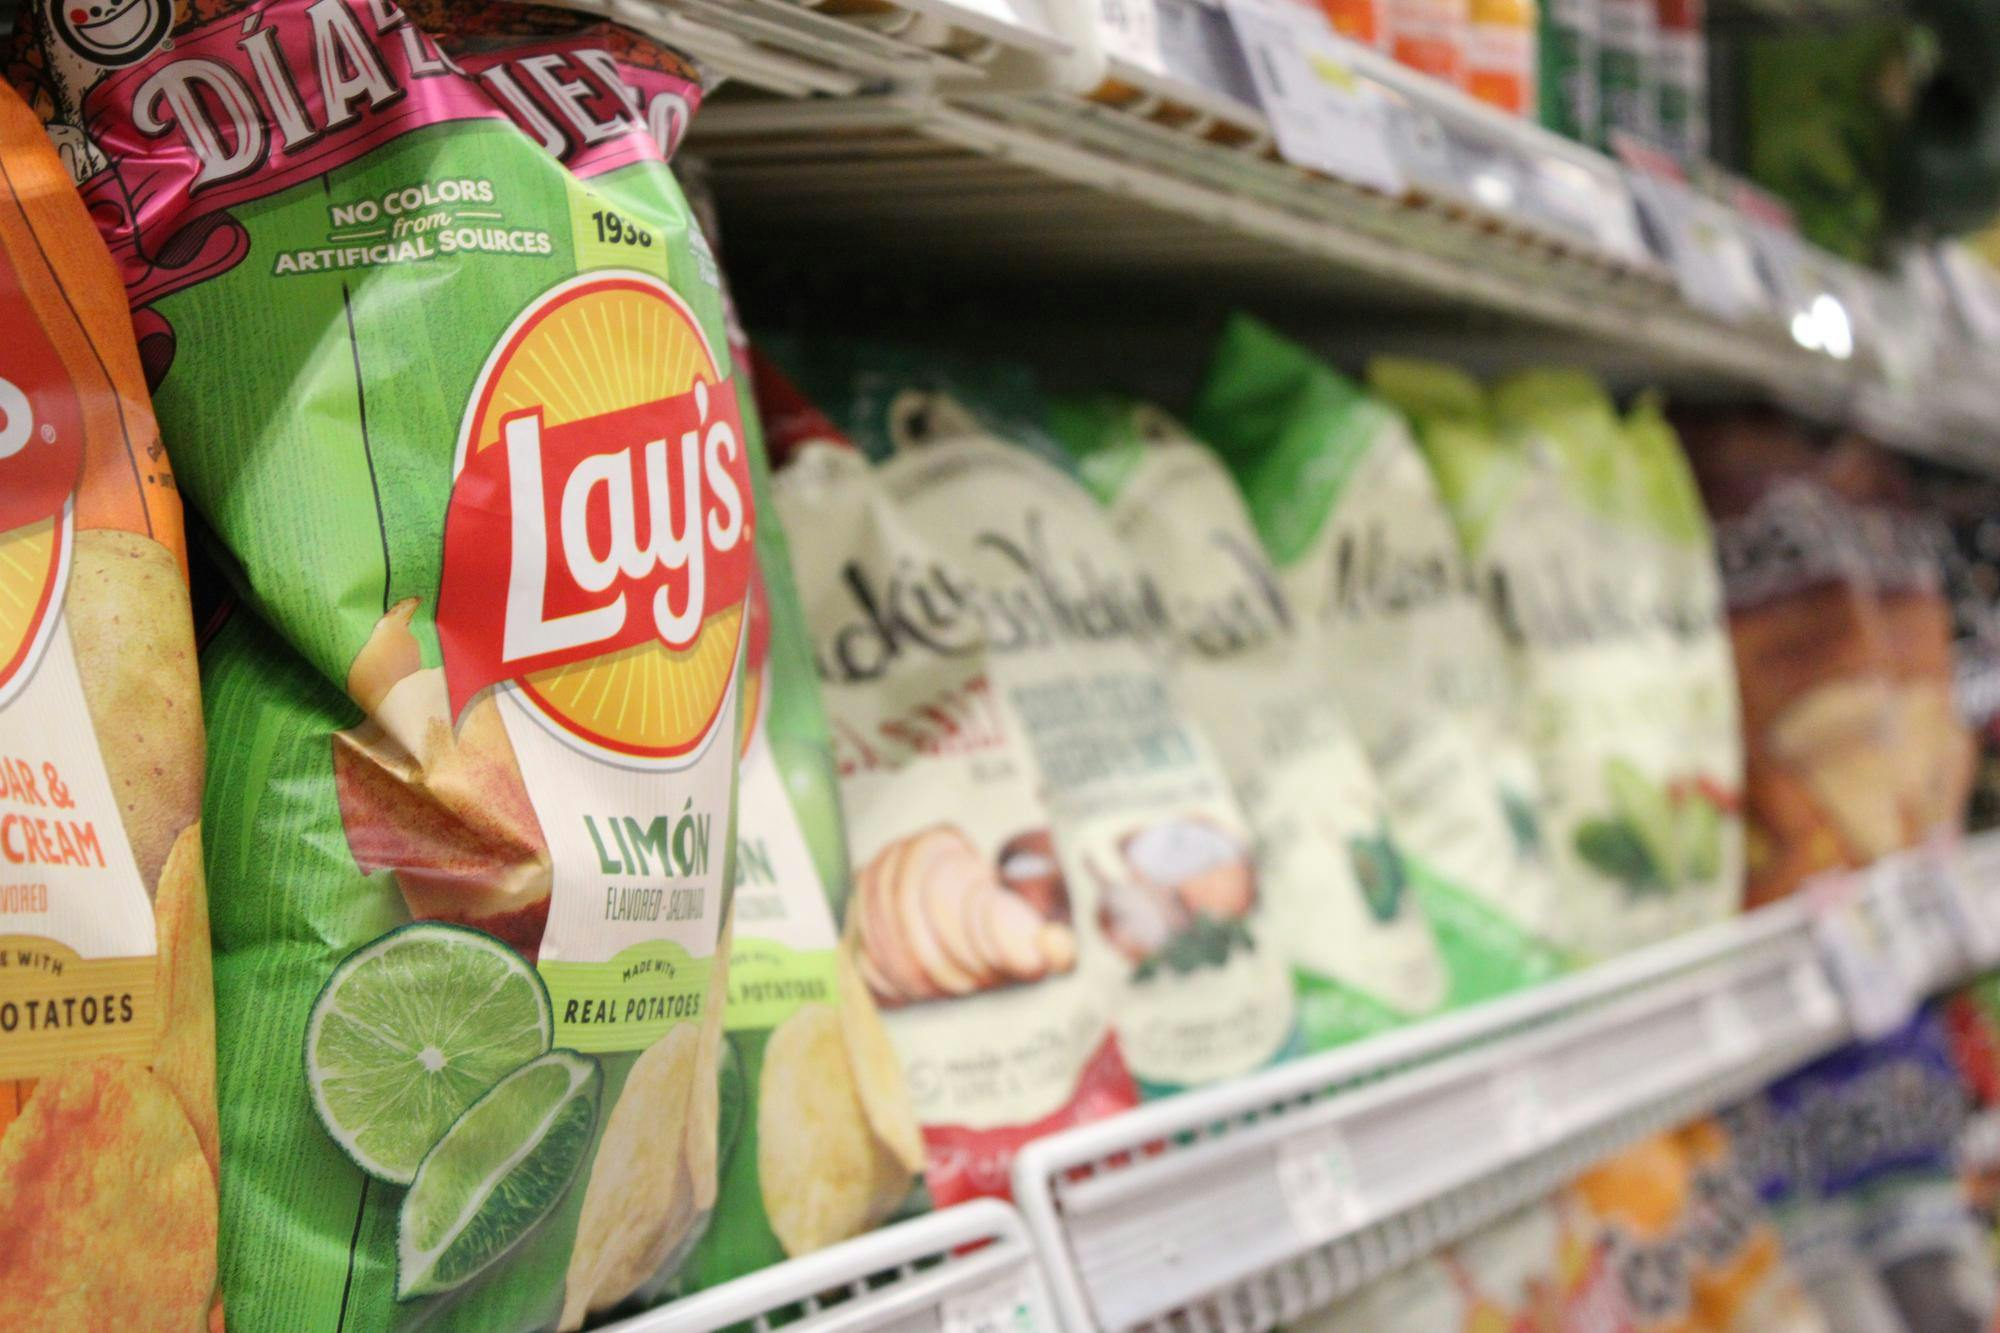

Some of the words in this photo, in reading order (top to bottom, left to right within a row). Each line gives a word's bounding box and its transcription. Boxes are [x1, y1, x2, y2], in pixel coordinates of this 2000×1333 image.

[132, 0, 402, 190] DÍA
[331, 200, 379, 226] NO
[383, 179, 495, 215] COLORS
[392, 210, 452, 239] from
[275, 236, 435, 275] ARTIFICIAL
[437, 227, 552, 255] SOURCES
[502, 380, 744, 664] Lay's
[42, 760, 76, 811] &
[1, 812, 107, 869] CREAM
[582, 795, 711, 878] LIMÓN
[605, 886, 664, 922] FLAVORED
[17, 950, 63, 977] WITH
[622, 959, 652, 983] MADE
[654, 958, 677, 980] WITH
[564, 998, 617, 1024] REAL
[624, 993, 702, 1023] POTATOES
